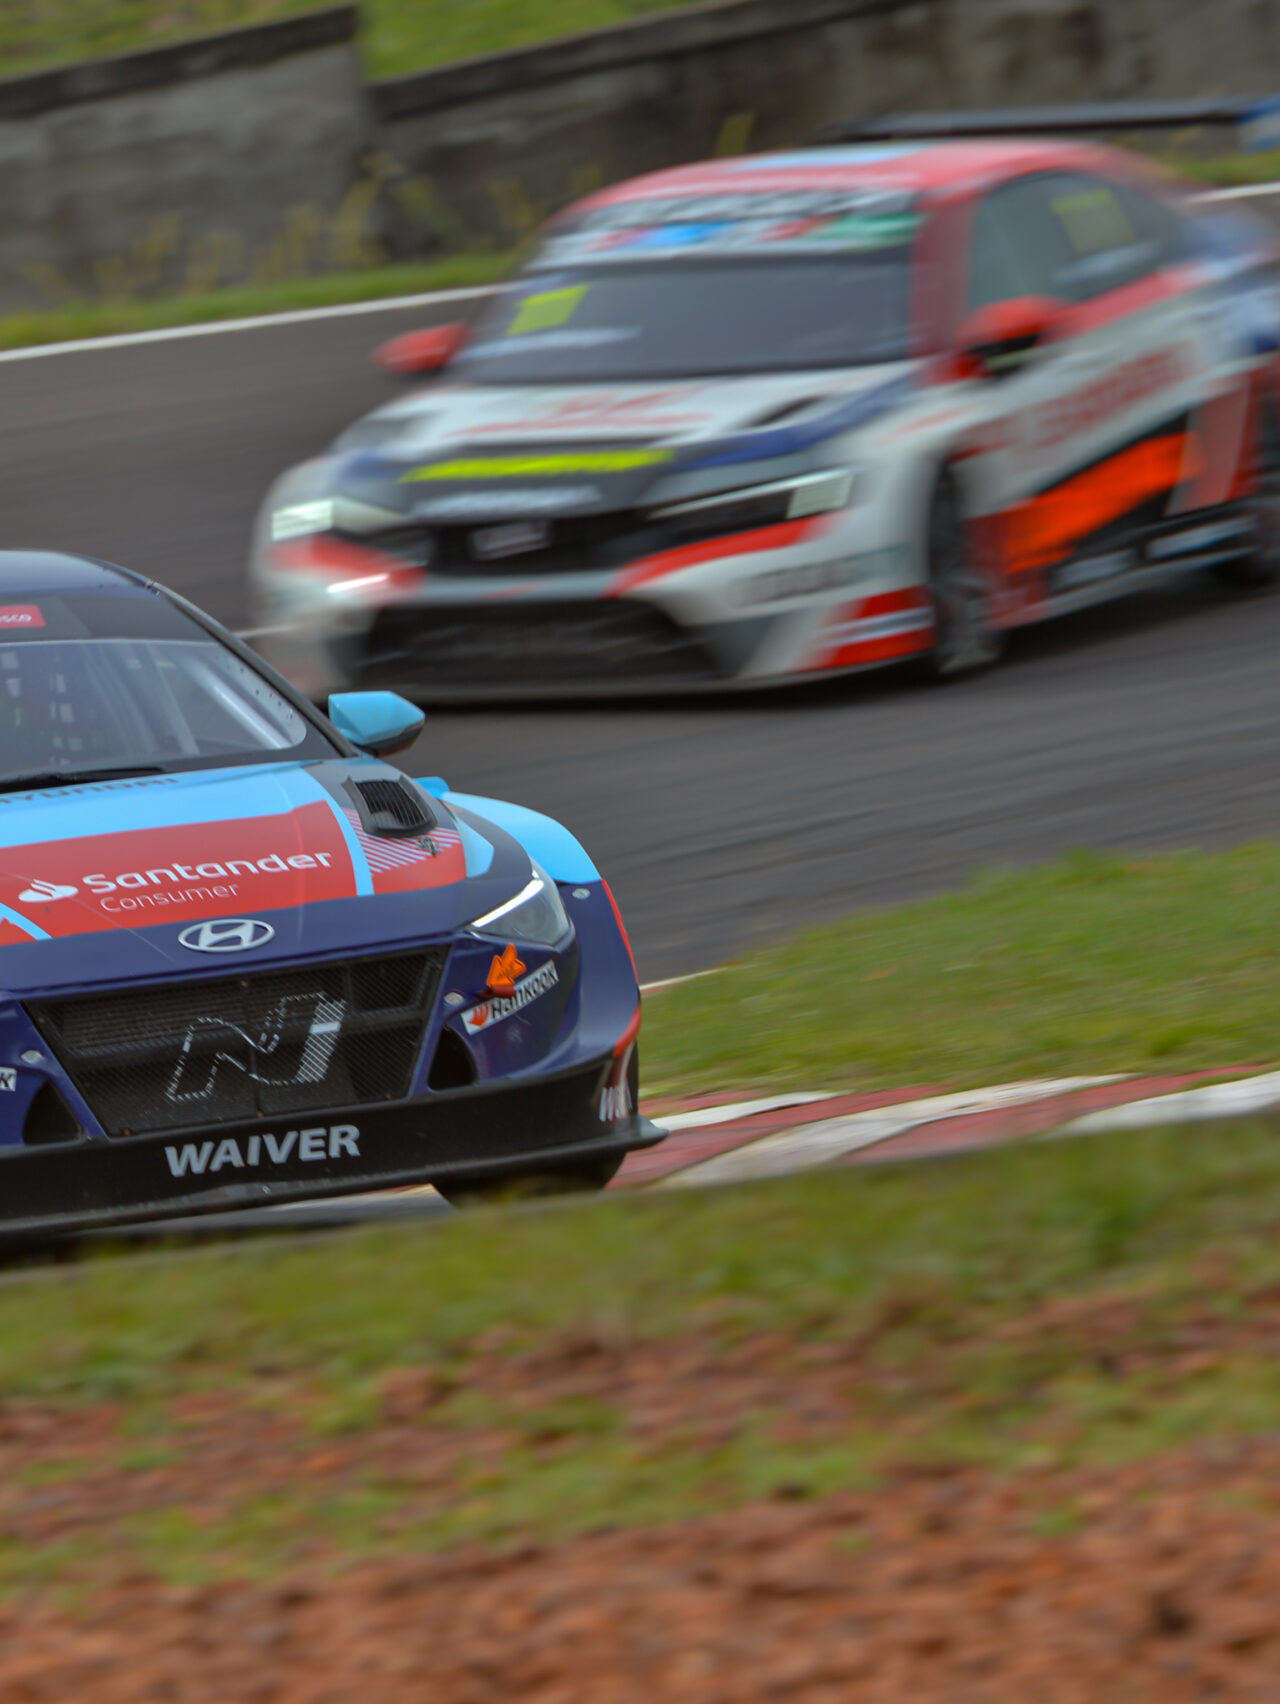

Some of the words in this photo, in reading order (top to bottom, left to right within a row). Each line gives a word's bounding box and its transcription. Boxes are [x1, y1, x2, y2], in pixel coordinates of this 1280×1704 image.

[82, 852, 332, 894] Santander
[100, 884, 239, 912] Consumer
[165, 1124, 361, 1177] WAIVER
